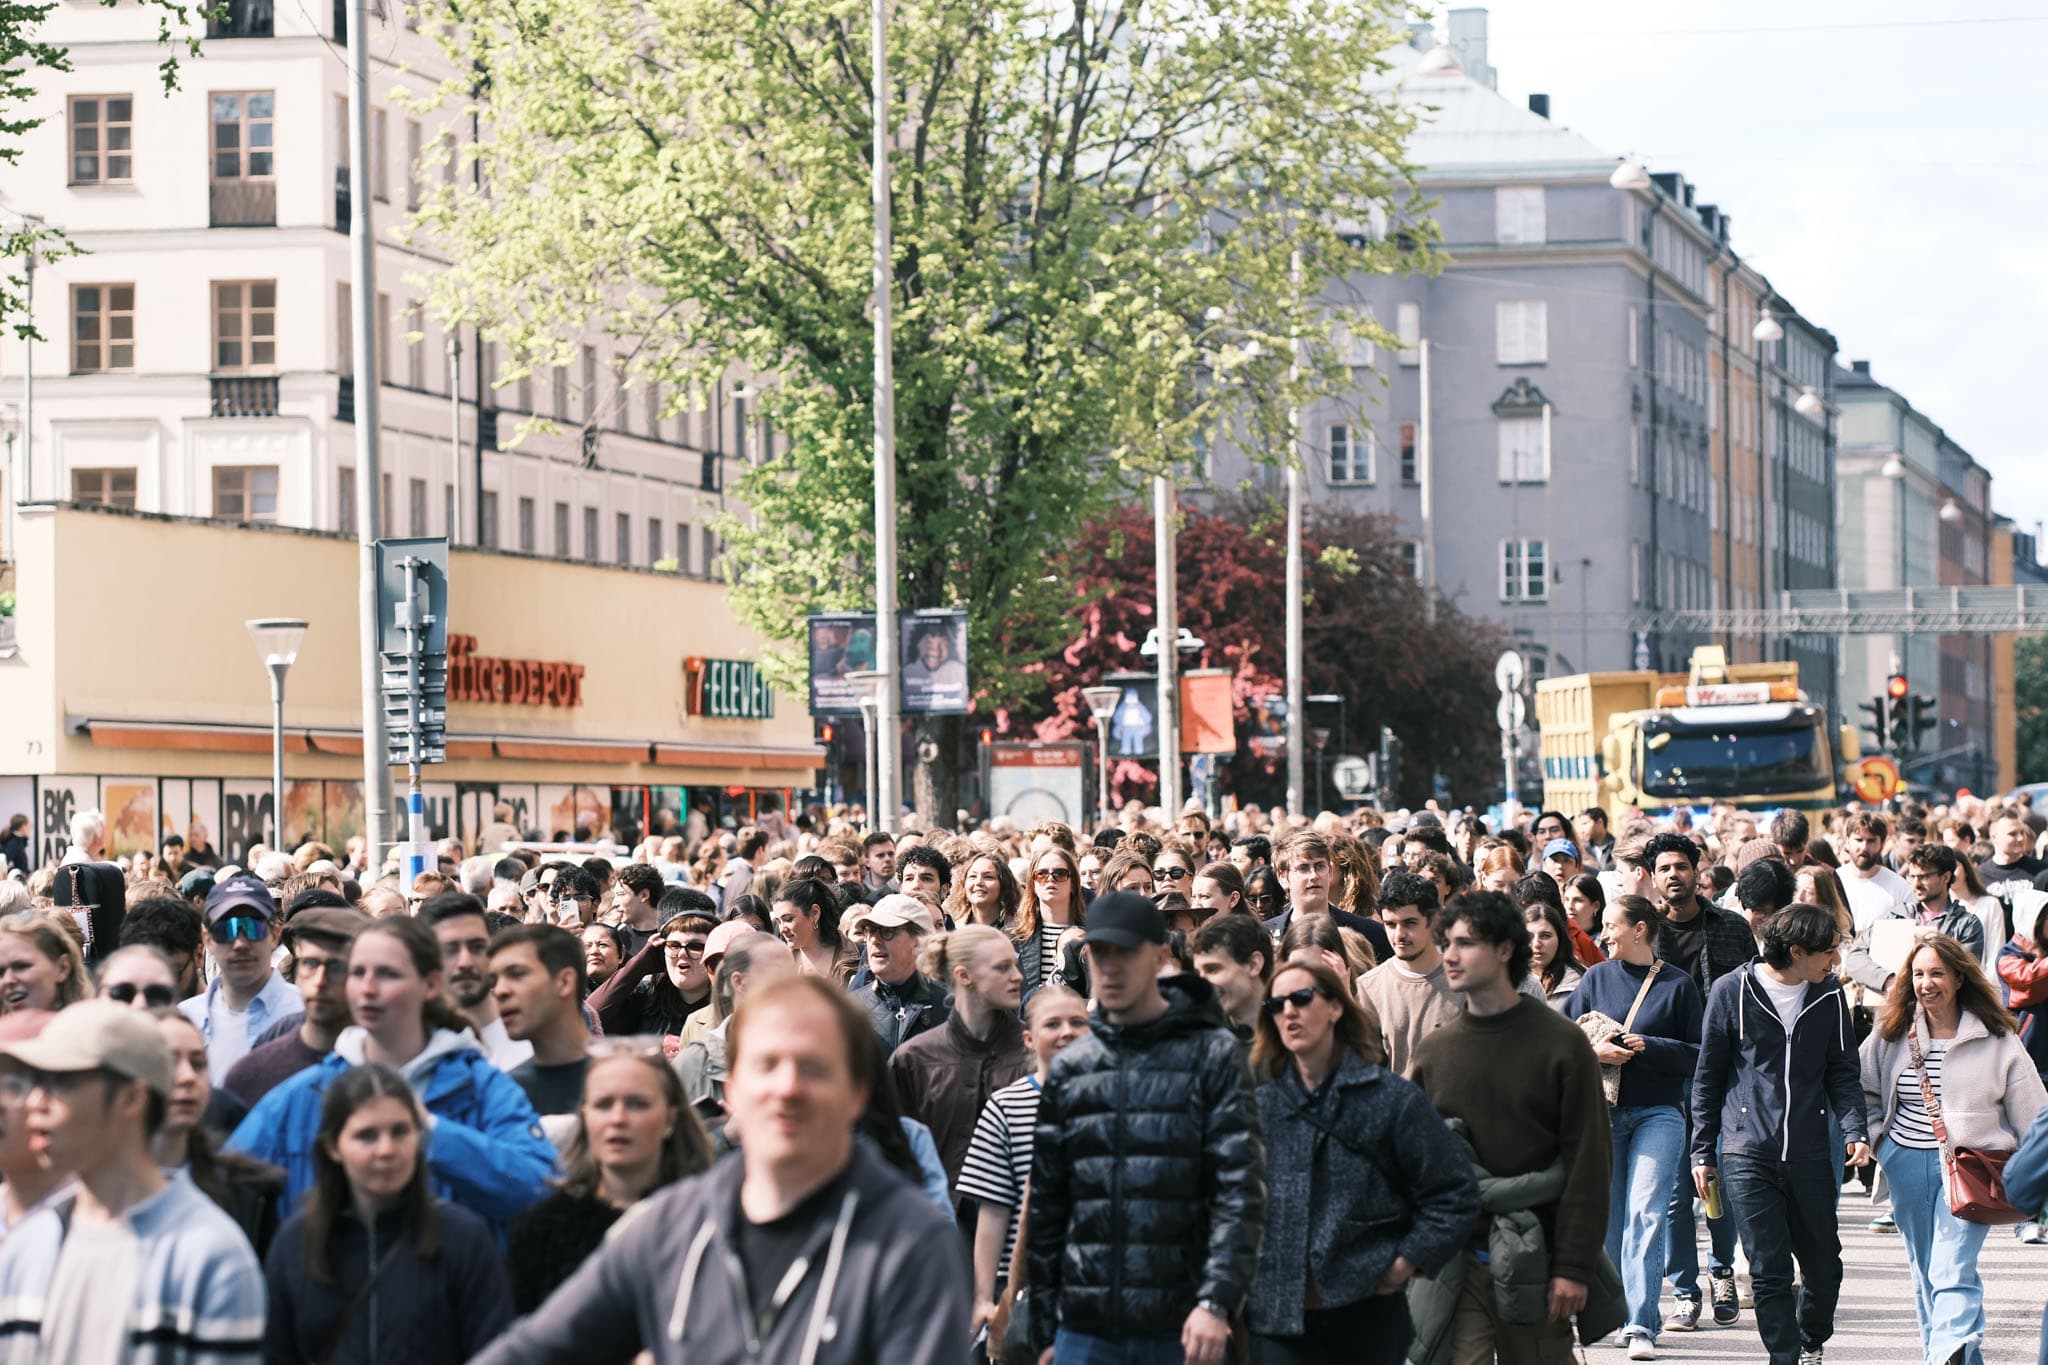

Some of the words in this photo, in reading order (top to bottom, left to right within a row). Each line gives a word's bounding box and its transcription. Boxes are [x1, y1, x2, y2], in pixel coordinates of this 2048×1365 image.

[447, 634, 505, 702] ffice
[509, 661, 584, 707] DEPOT
[44, 788, 76, 834] BIG
